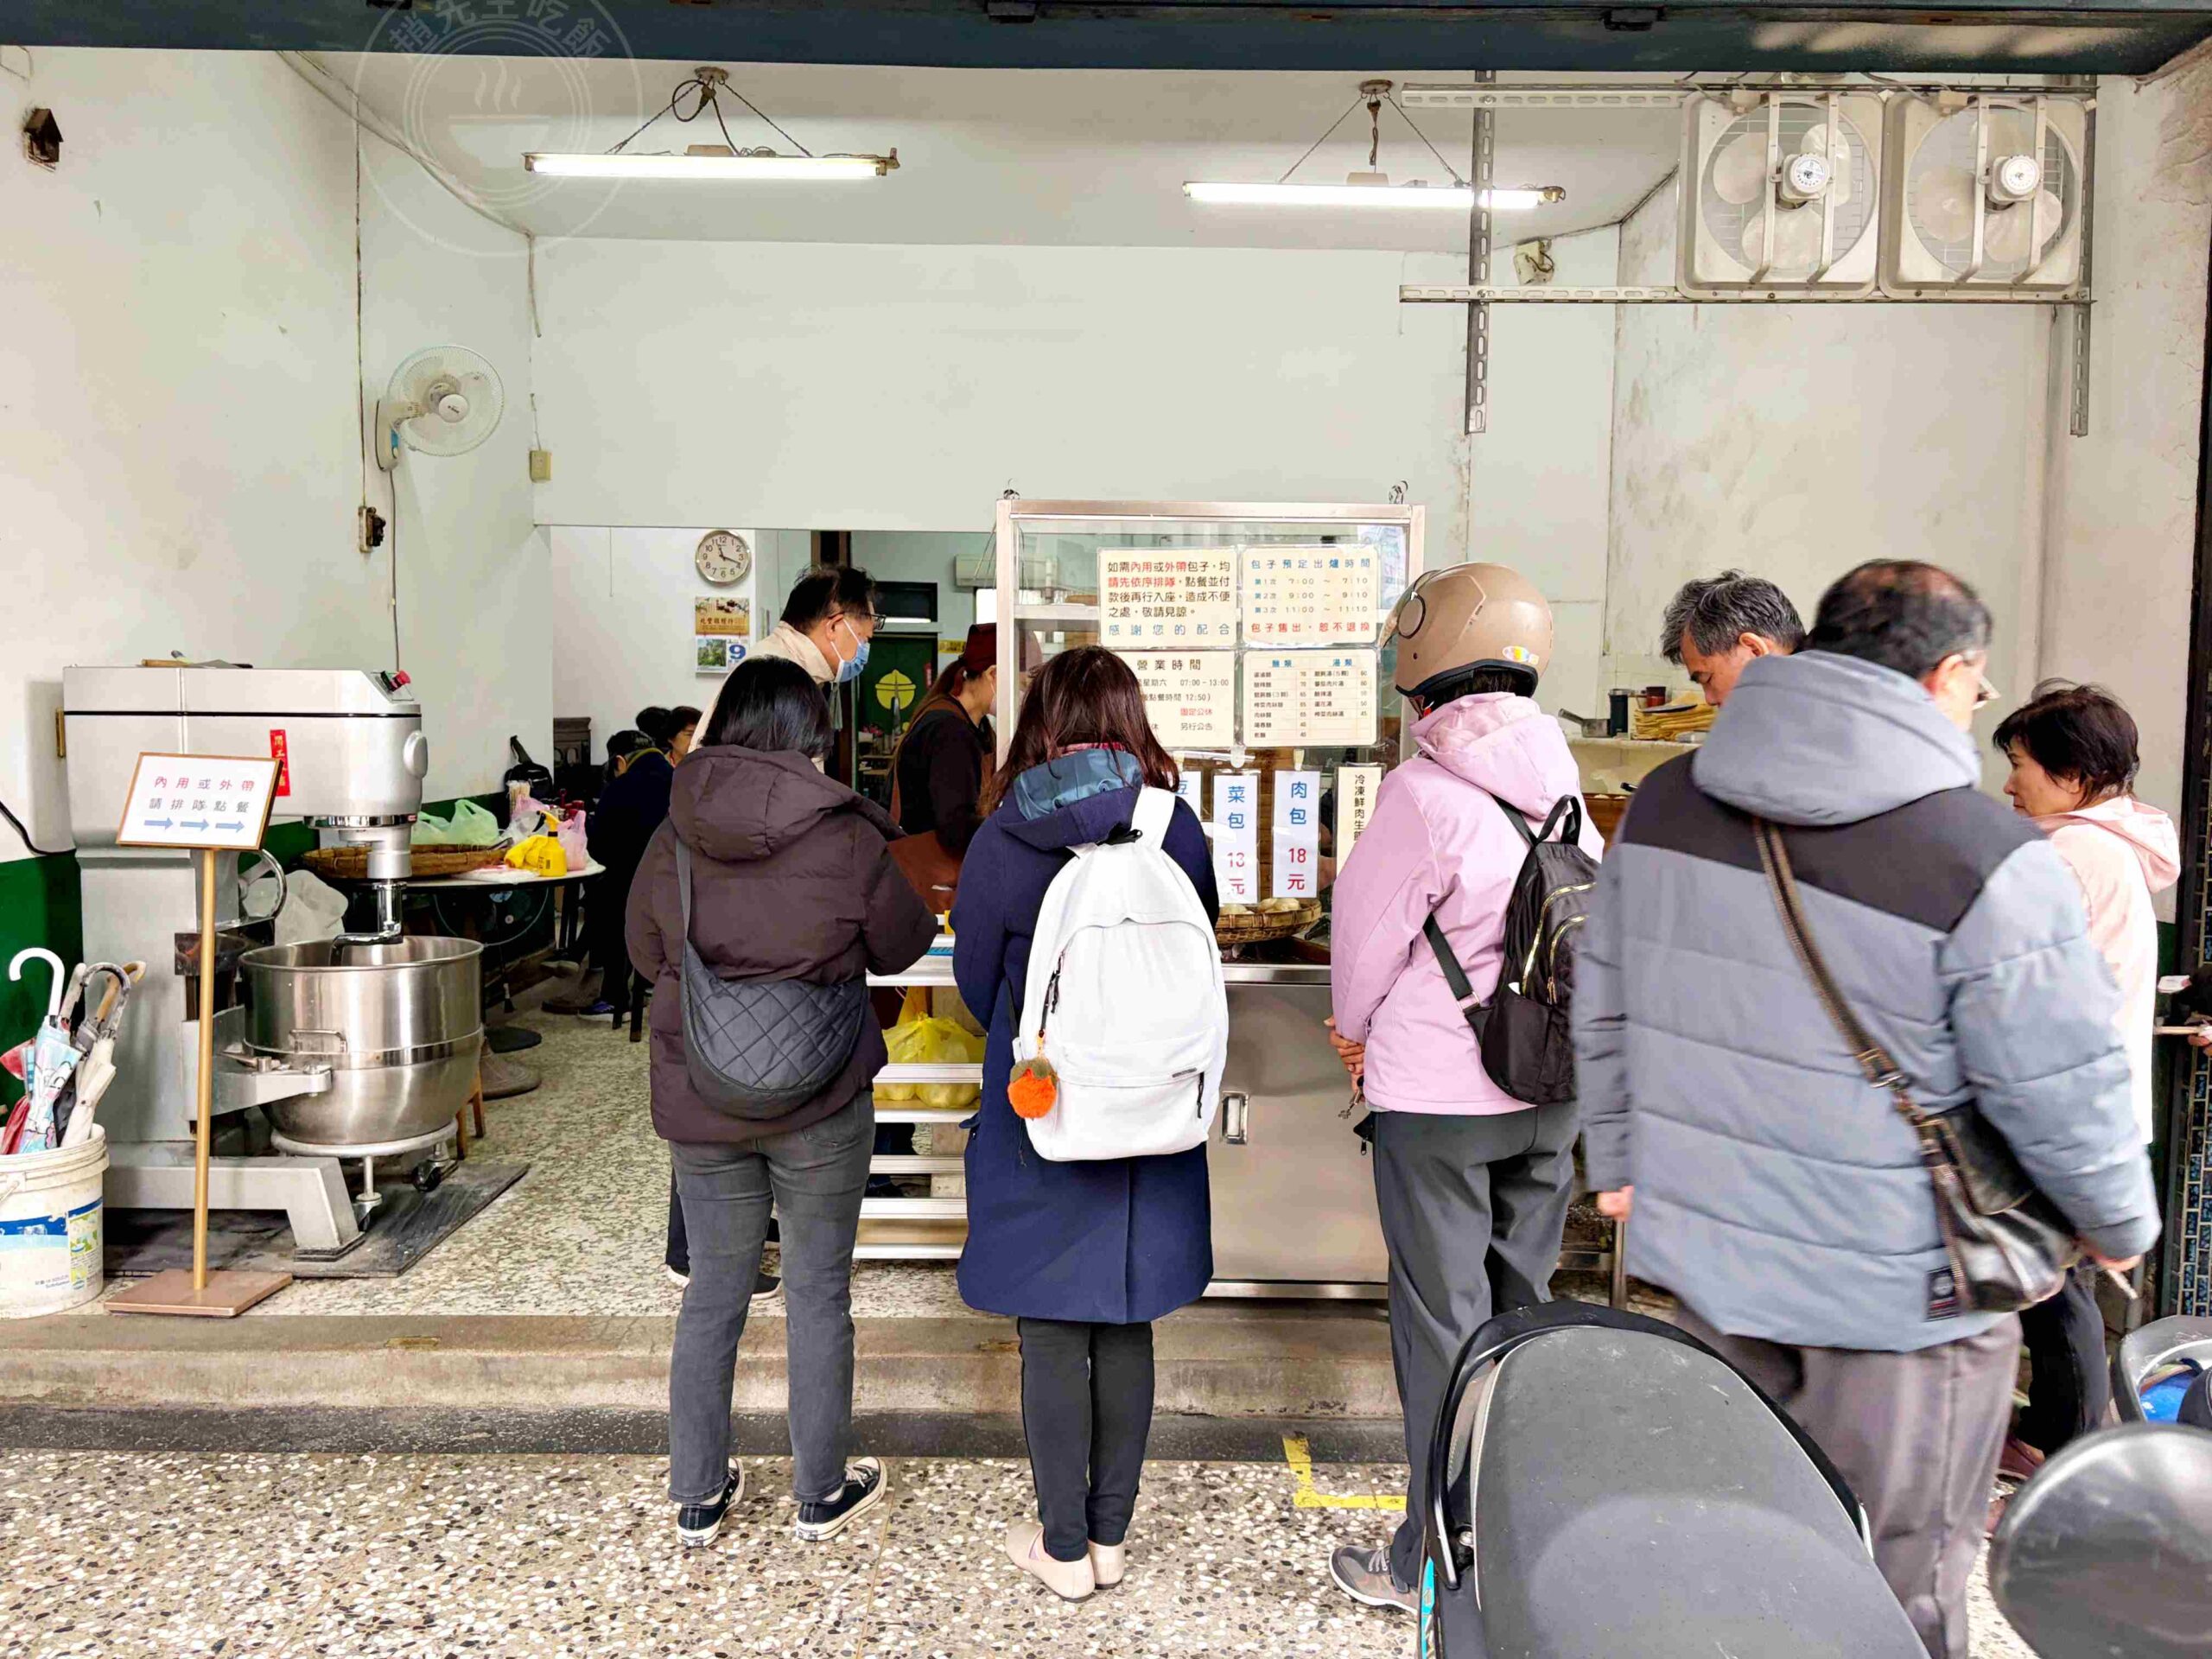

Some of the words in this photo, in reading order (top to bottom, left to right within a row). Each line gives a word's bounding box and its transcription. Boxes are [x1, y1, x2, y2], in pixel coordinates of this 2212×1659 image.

[1109, 623, 1230, 636] 感謝您的配合
[729, 644, 746, 659] 9
[1137, 659, 1201, 671] 營業時間
[155, 776, 255, 791] 內用或外帶
[149, 798, 250, 813] 請排隊點餐
[1227, 785, 1245, 830] 菜包
[1289, 781, 1307, 825] 肉包
